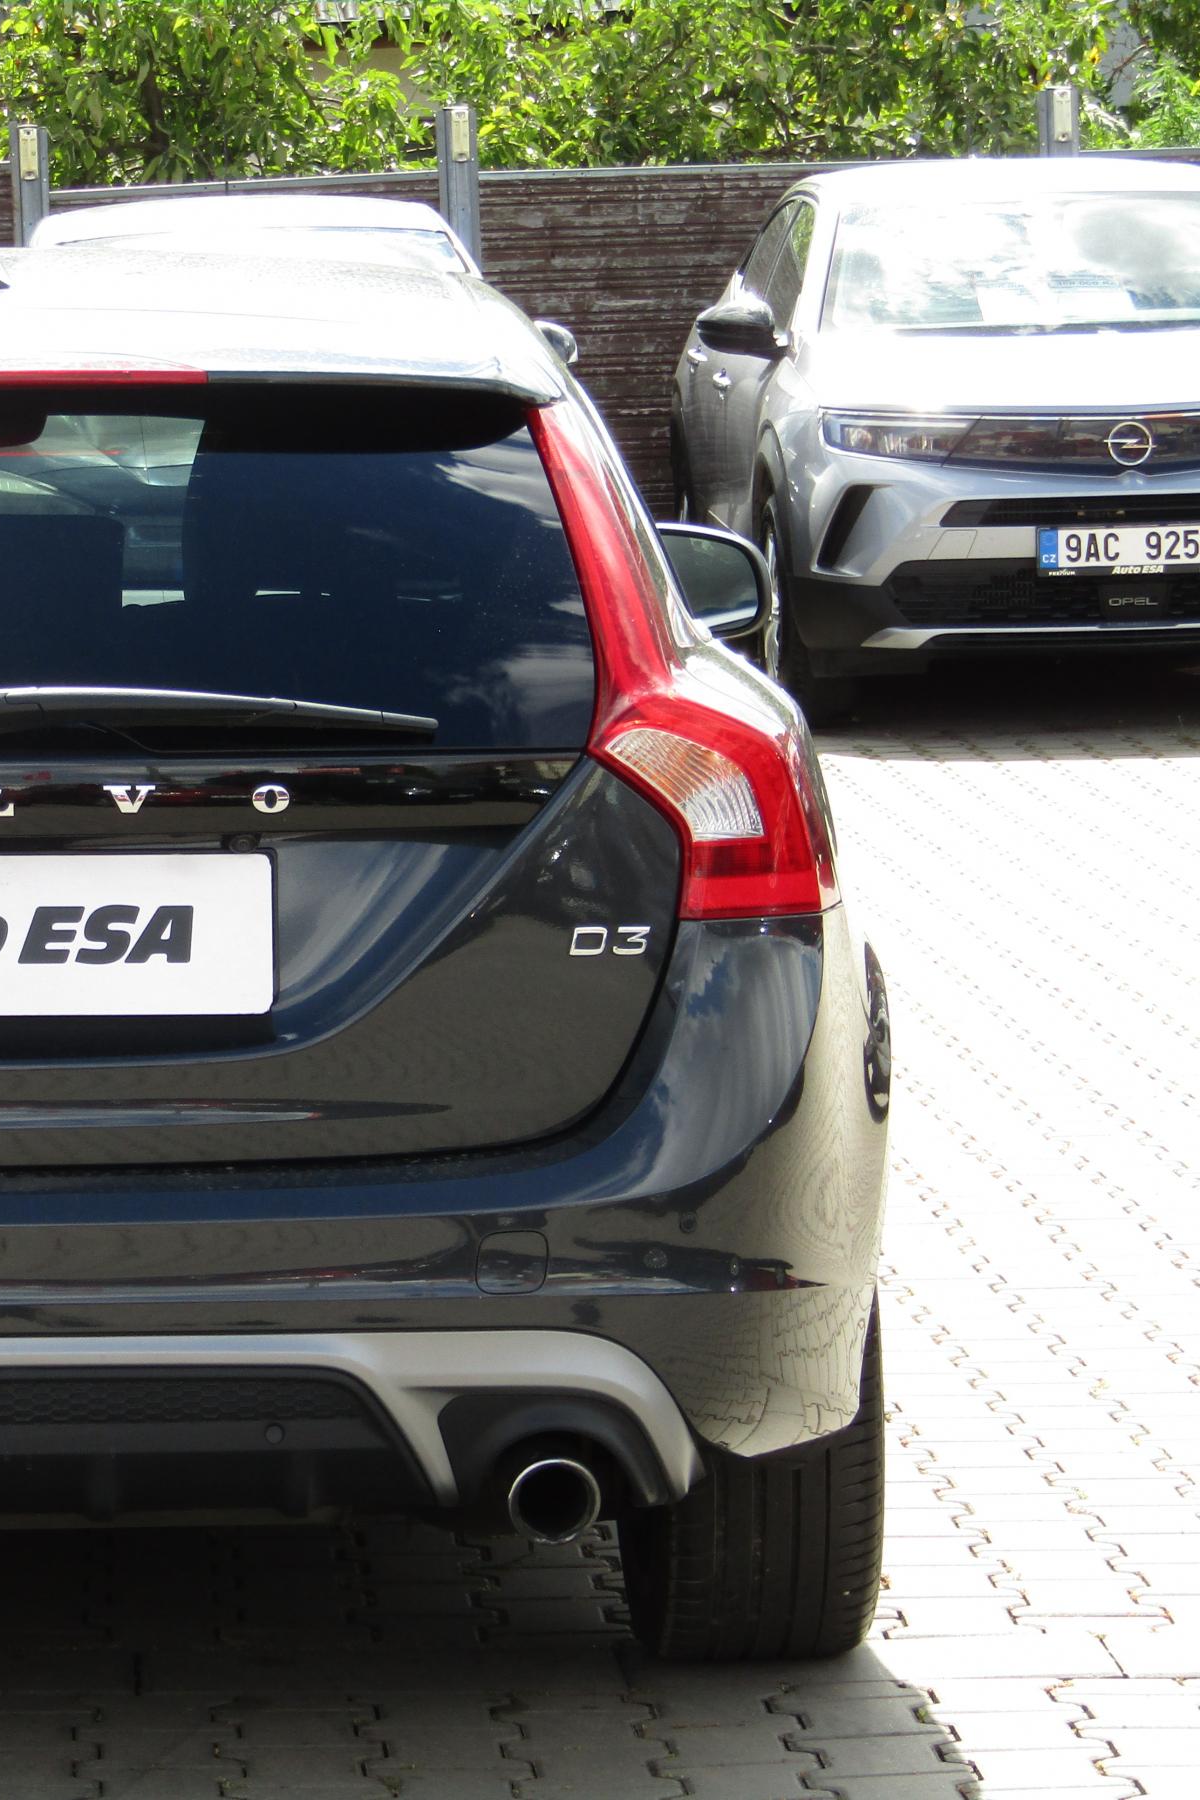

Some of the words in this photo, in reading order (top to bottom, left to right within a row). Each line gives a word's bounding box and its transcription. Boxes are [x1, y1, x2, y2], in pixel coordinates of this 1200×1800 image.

[1065, 532, 1120, 563] 9AC
[1145, 530, 1200, 561] 925
[1042, 554, 1056, 563] CZ
[1111, 565, 1141, 575] Auto
[1142, 565, 1164, 574] ESA
[1108, 597, 1159, 606] OPEL
[17, 904, 194, 966] ESA
[569, 926, 651, 956] D3
